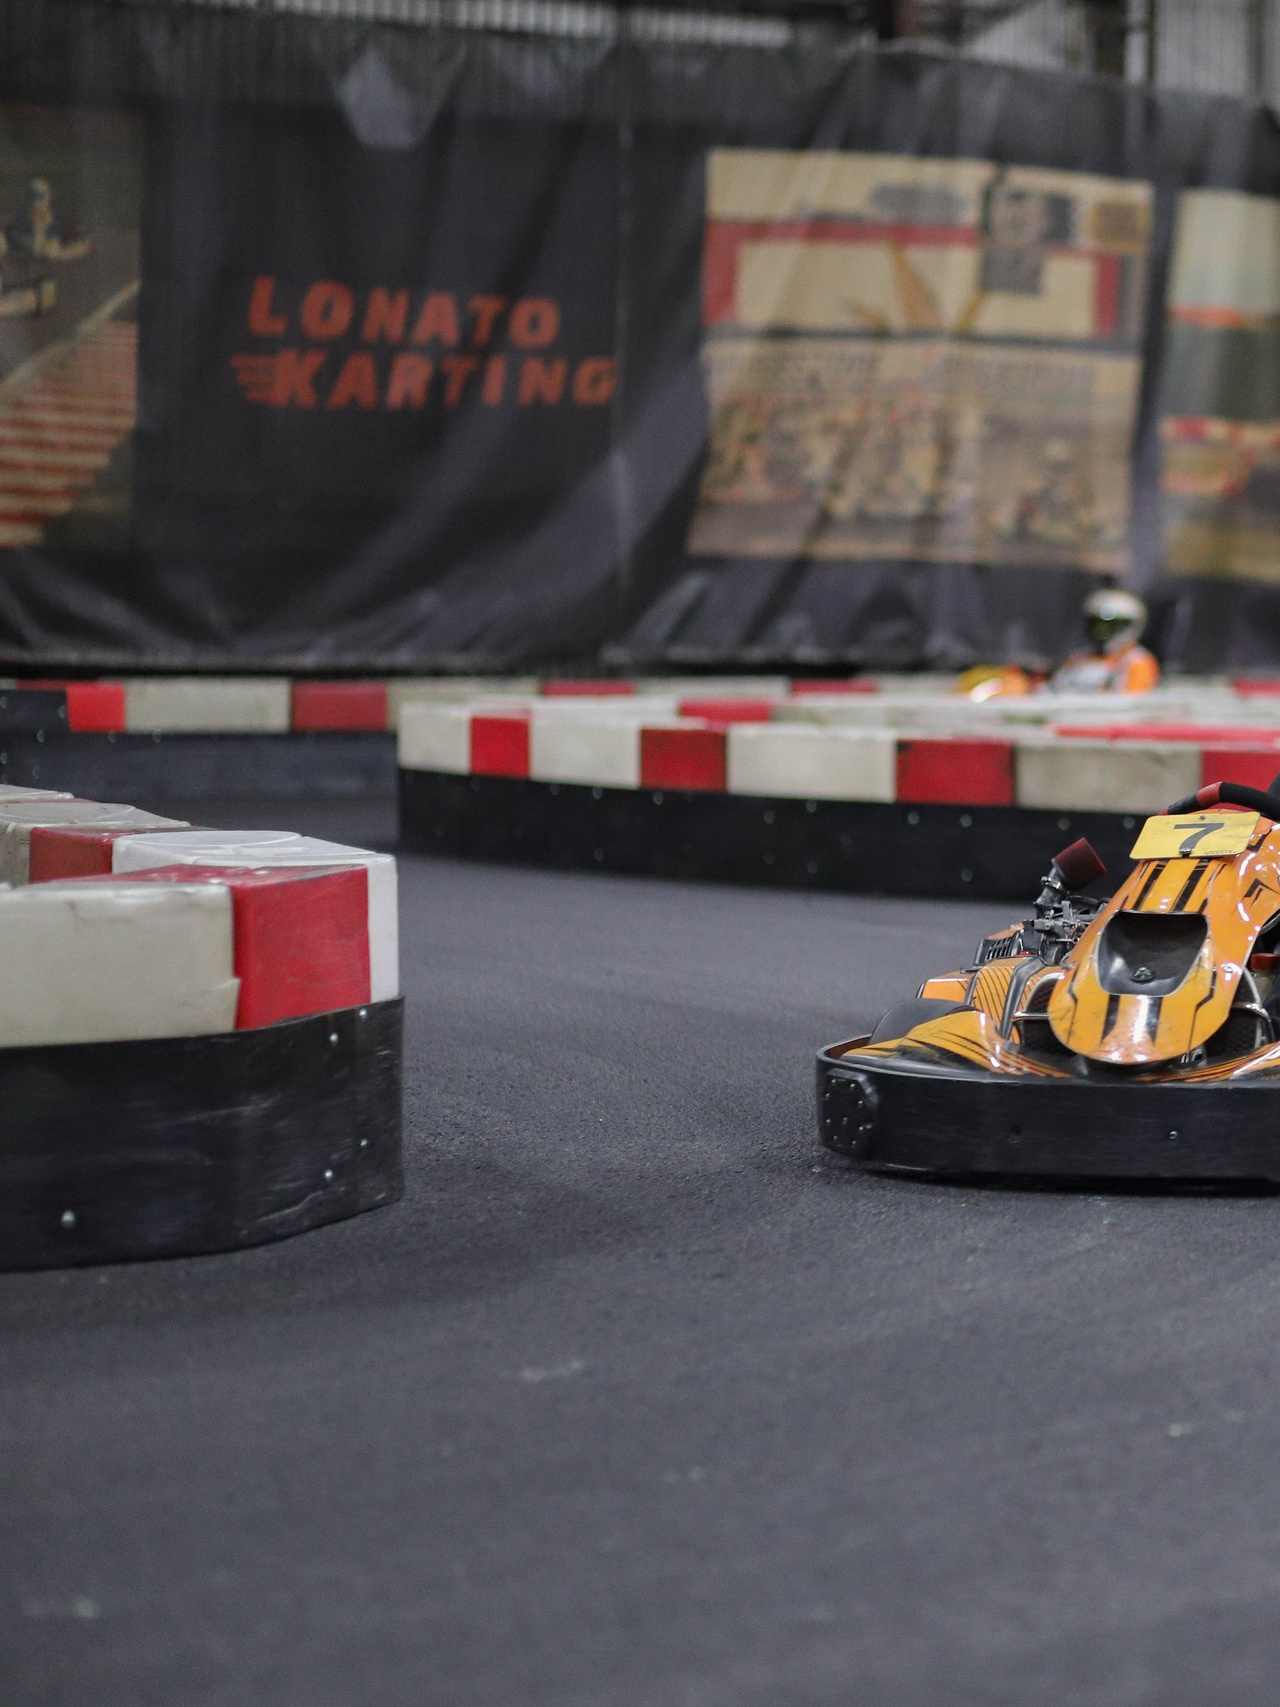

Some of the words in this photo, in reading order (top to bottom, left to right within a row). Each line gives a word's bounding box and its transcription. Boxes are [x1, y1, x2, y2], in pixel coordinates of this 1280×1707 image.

[248, 275, 560, 350] LONATO
[266, 349, 617, 409] KARTING
[1173, 823, 1225, 852] 7
